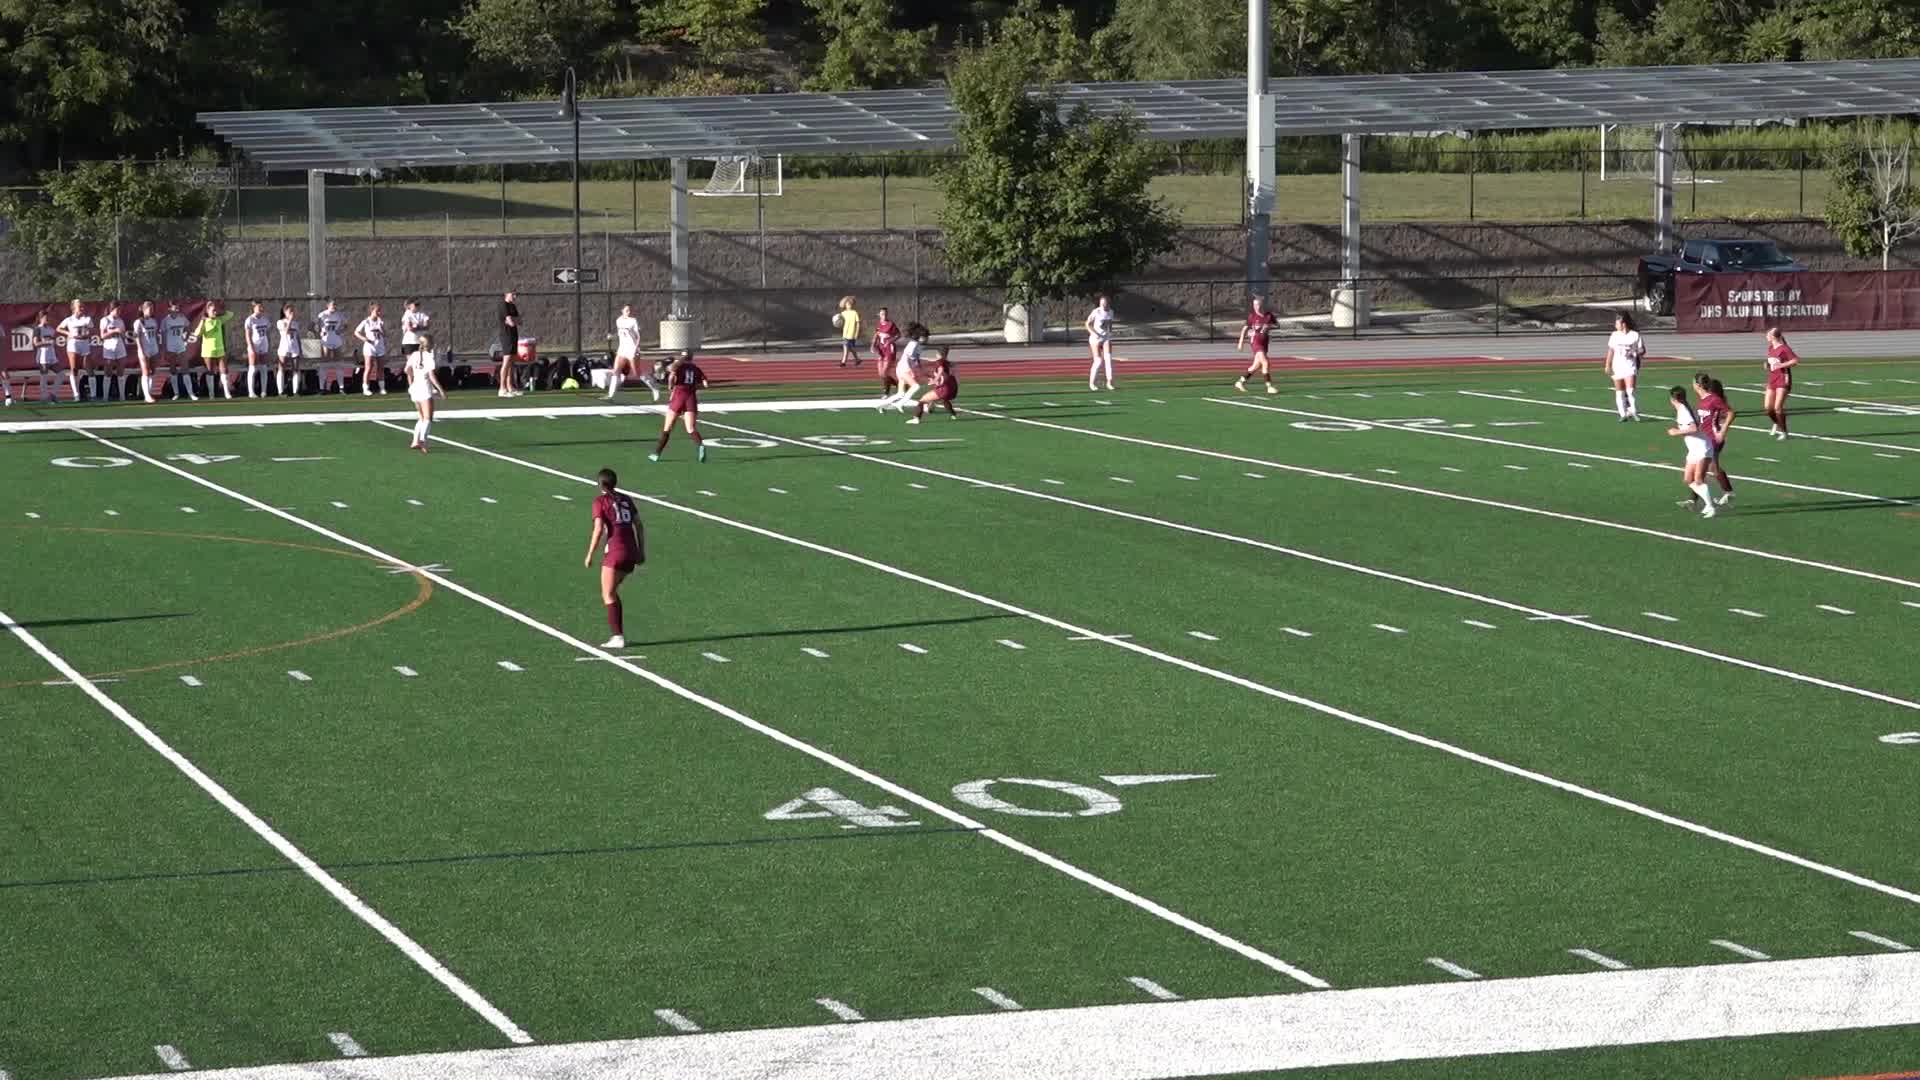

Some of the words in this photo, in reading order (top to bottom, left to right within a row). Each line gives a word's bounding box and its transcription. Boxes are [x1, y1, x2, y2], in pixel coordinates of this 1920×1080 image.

[1788, 289, 1801, 302] BY
[1700, 305, 1722, 318] DHS
[1766, 303, 1829, 317] ASSOCIATION
[764, 778, 1122, 829] 40
